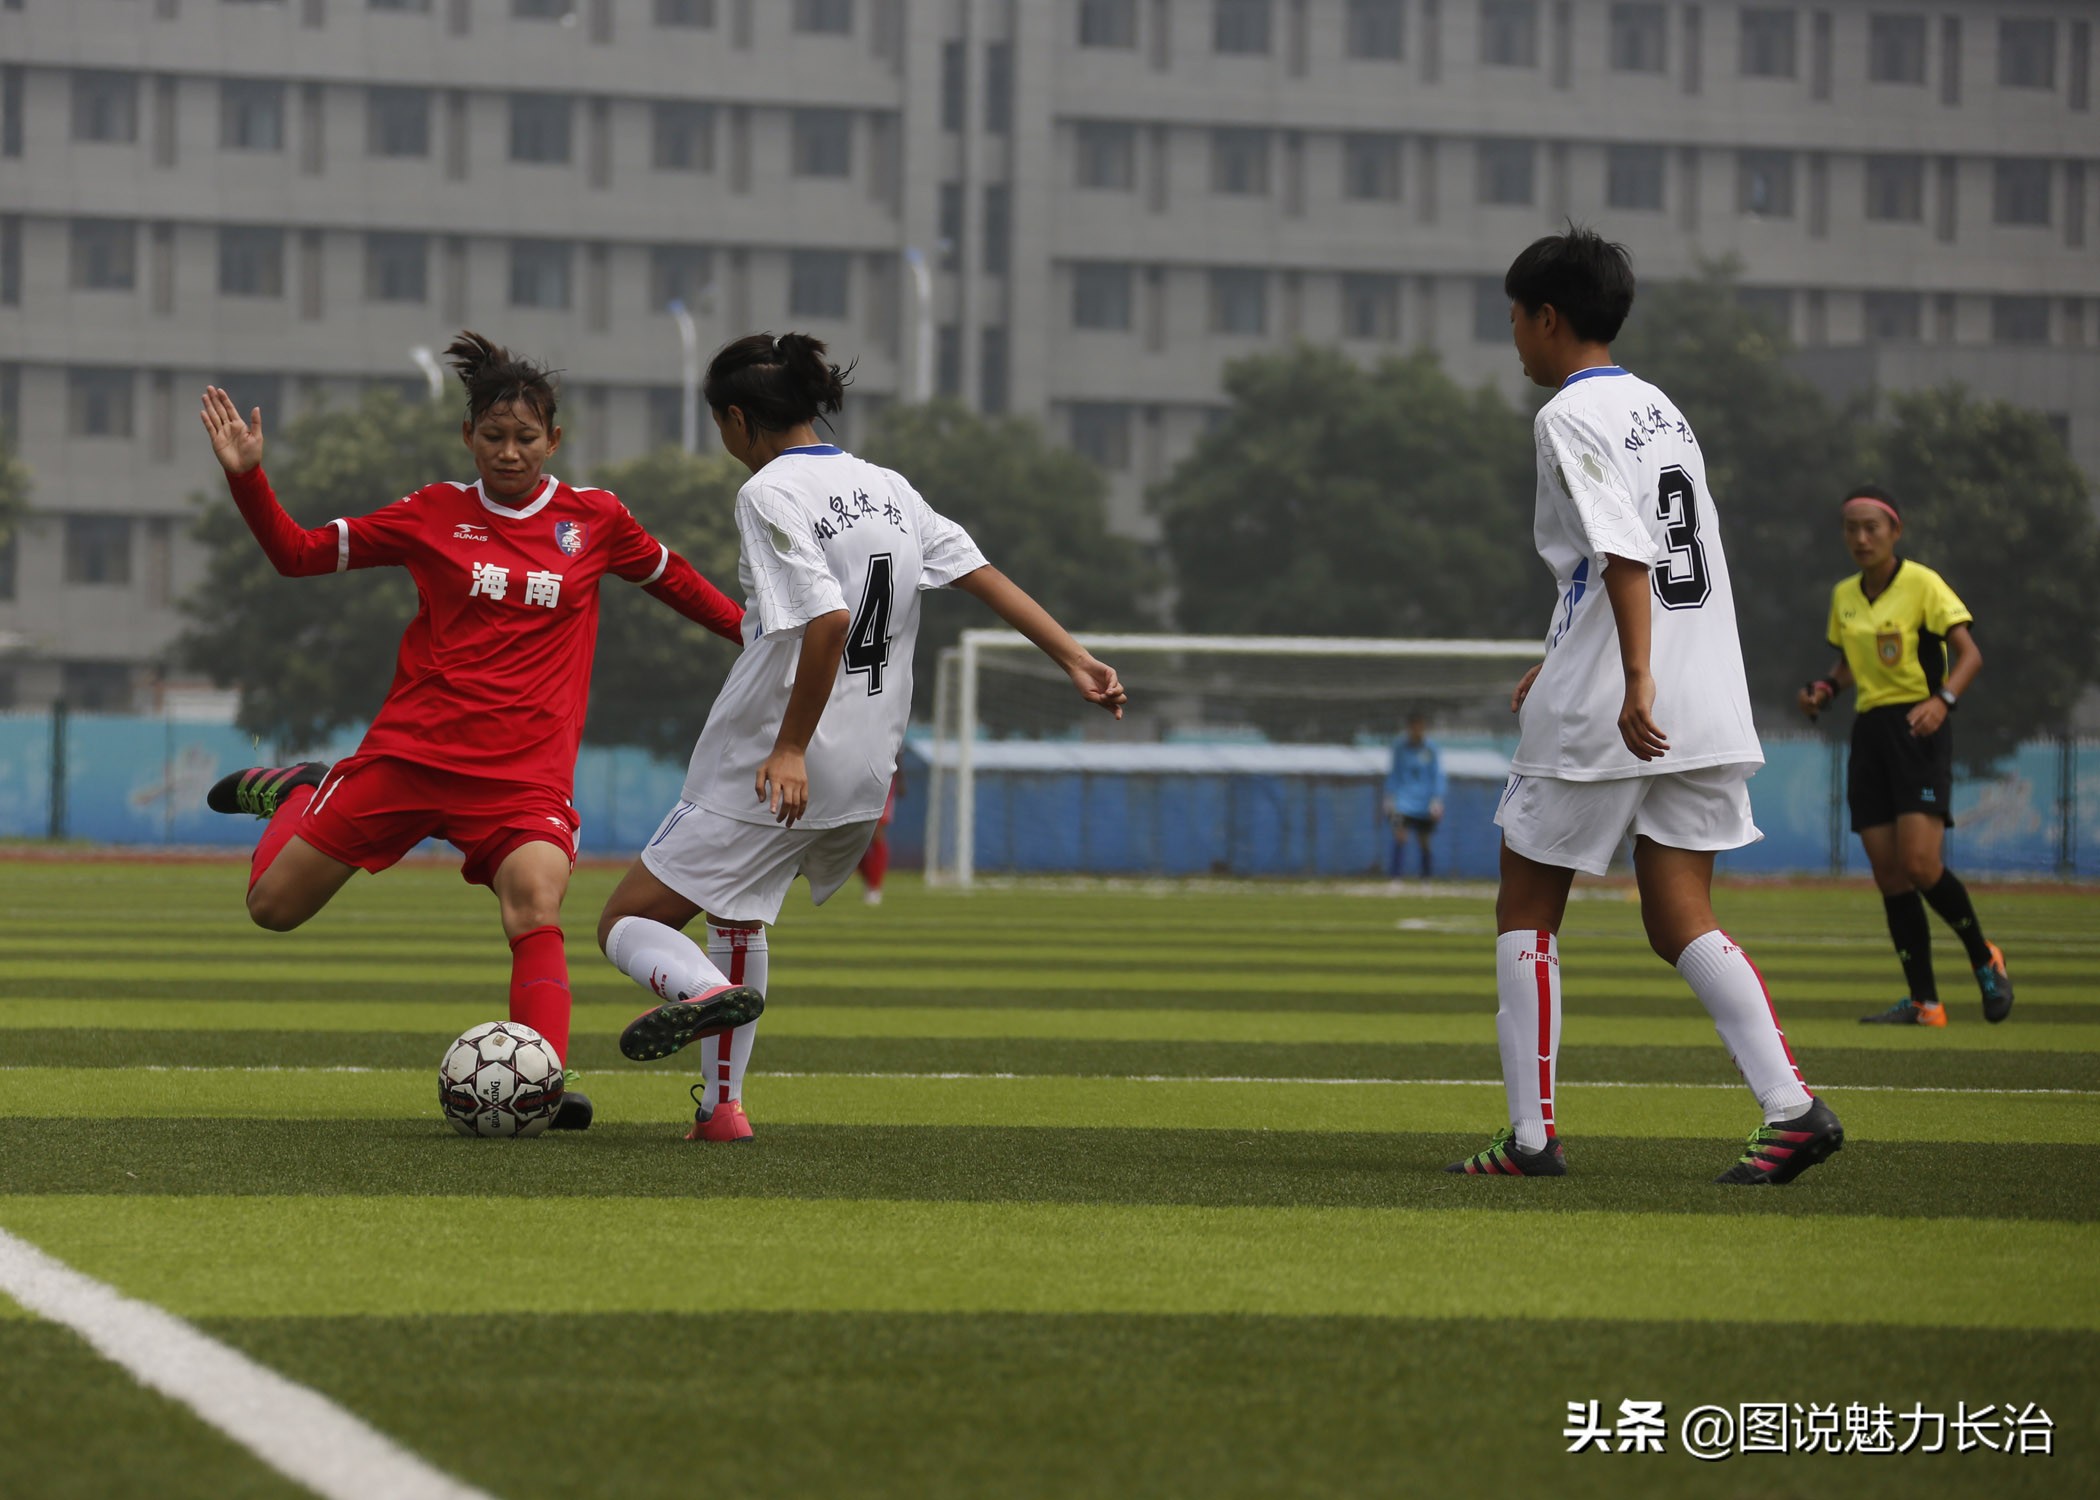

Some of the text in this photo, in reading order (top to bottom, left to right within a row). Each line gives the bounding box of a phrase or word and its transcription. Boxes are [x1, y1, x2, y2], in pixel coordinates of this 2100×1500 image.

[453, 531, 489, 542] SUNAIS
[1651, 464, 1712, 611] 3
[469, 561, 563, 609] 海南
[844, 552, 894, 697] 4
